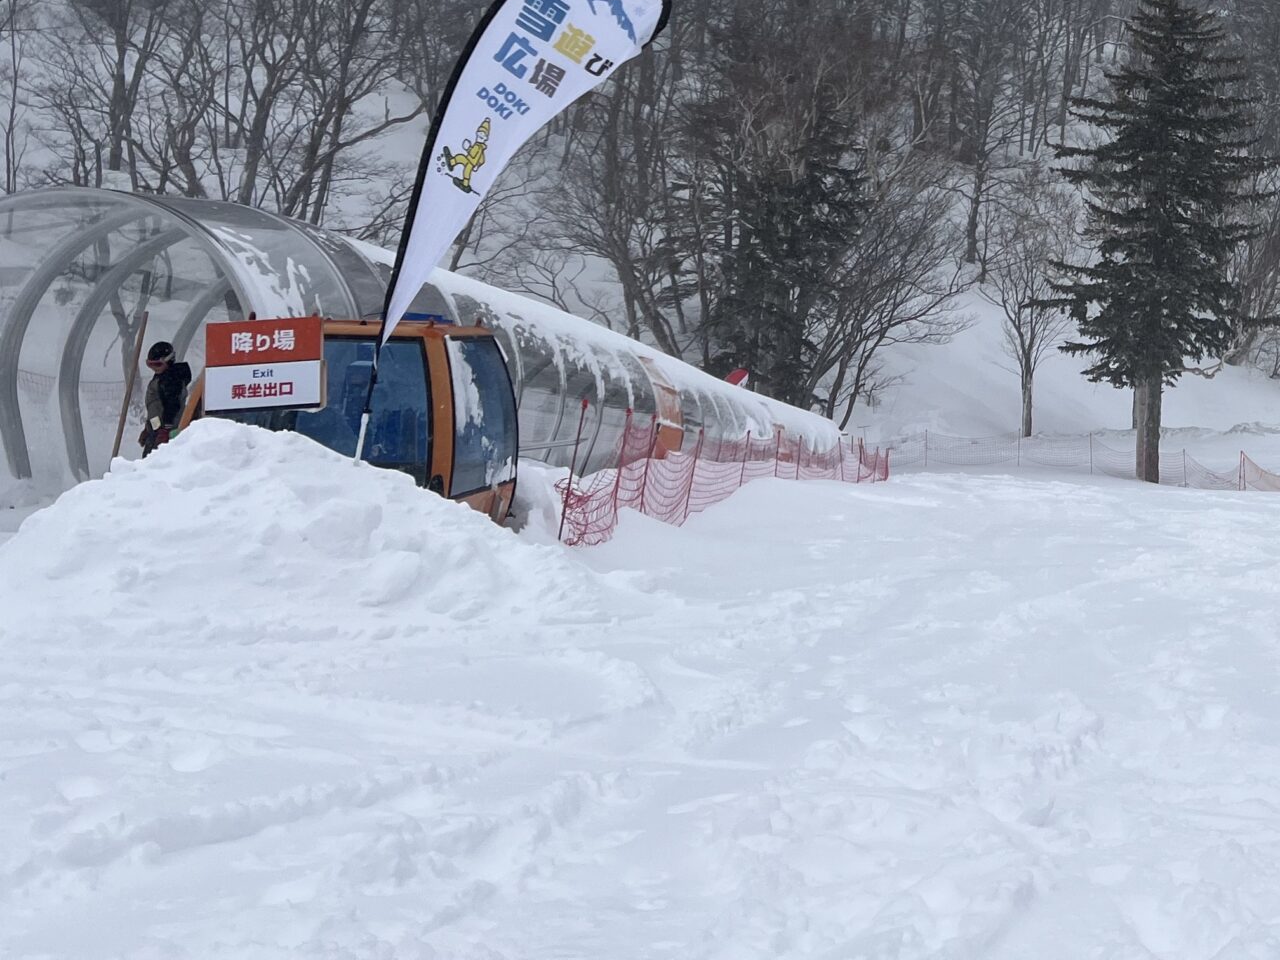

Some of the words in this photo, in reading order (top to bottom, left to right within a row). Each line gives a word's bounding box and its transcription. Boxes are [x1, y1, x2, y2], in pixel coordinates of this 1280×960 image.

[493, 31, 567, 99] 広場
[476, 87, 514, 120] DOKI
[493, 82, 530, 116] DOKI
[231, 329, 295, 354] 降り場
[252, 369, 274, 378] Exit
